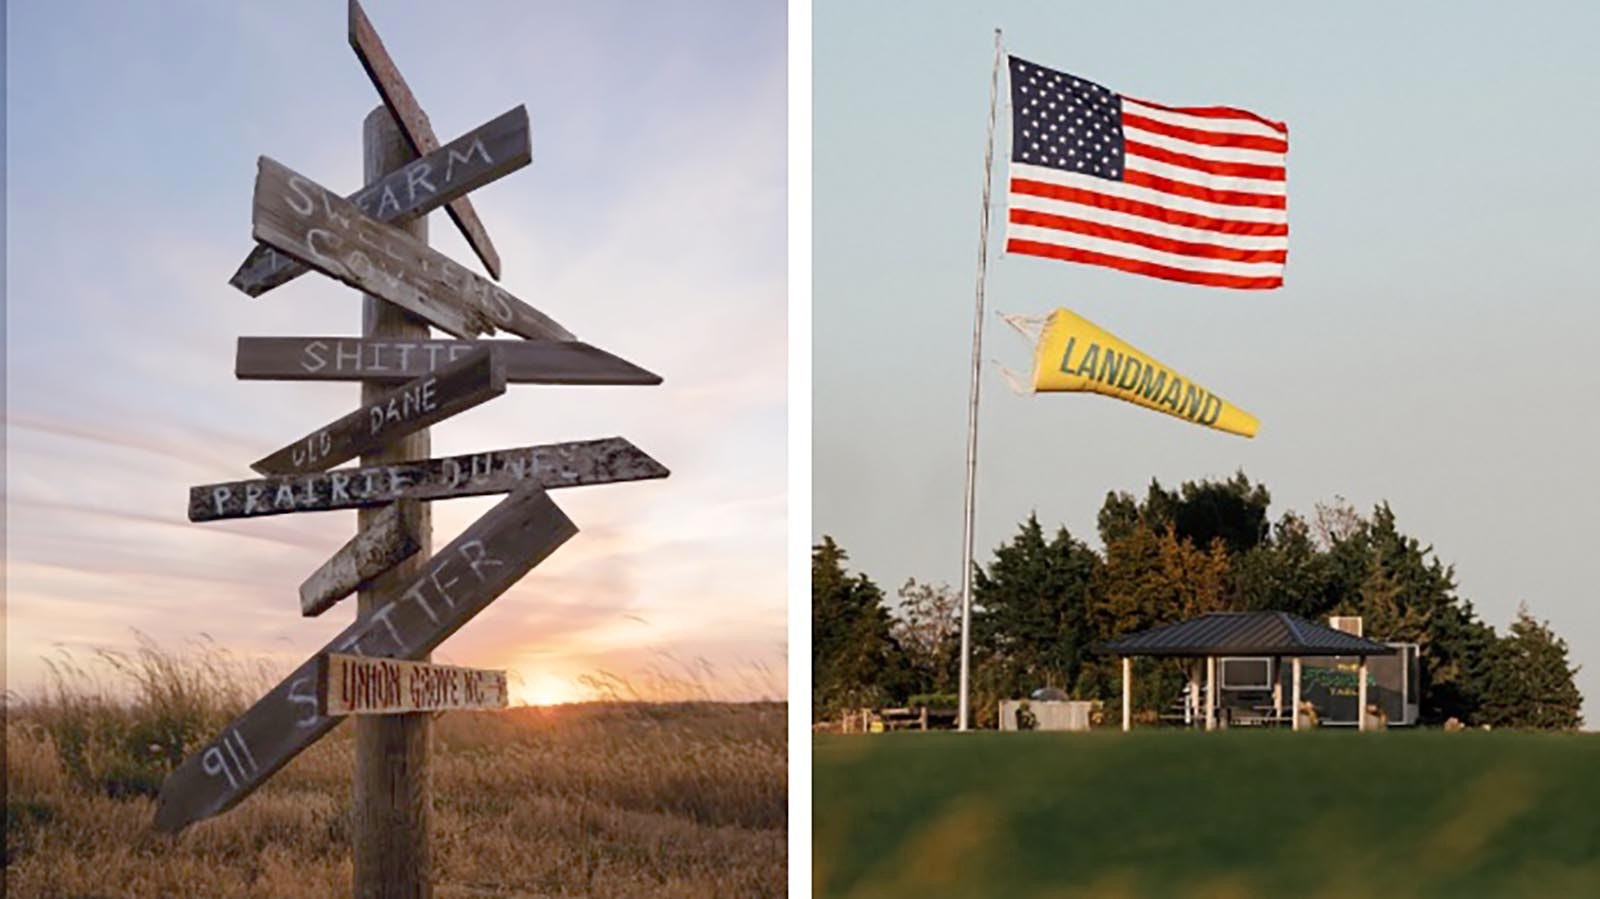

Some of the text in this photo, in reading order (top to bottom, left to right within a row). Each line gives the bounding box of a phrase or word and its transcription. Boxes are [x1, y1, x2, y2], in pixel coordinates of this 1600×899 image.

[300, 341, 473, 374] SHITTE
[1059, 336, 1224, 427] LANDMAND
[369, 377, 437, 437] DANE
[211, 465, 406, 515] PRAIRIE
[341, 660, 402, 711] UNION
[201, 729, 258, 791] 911
